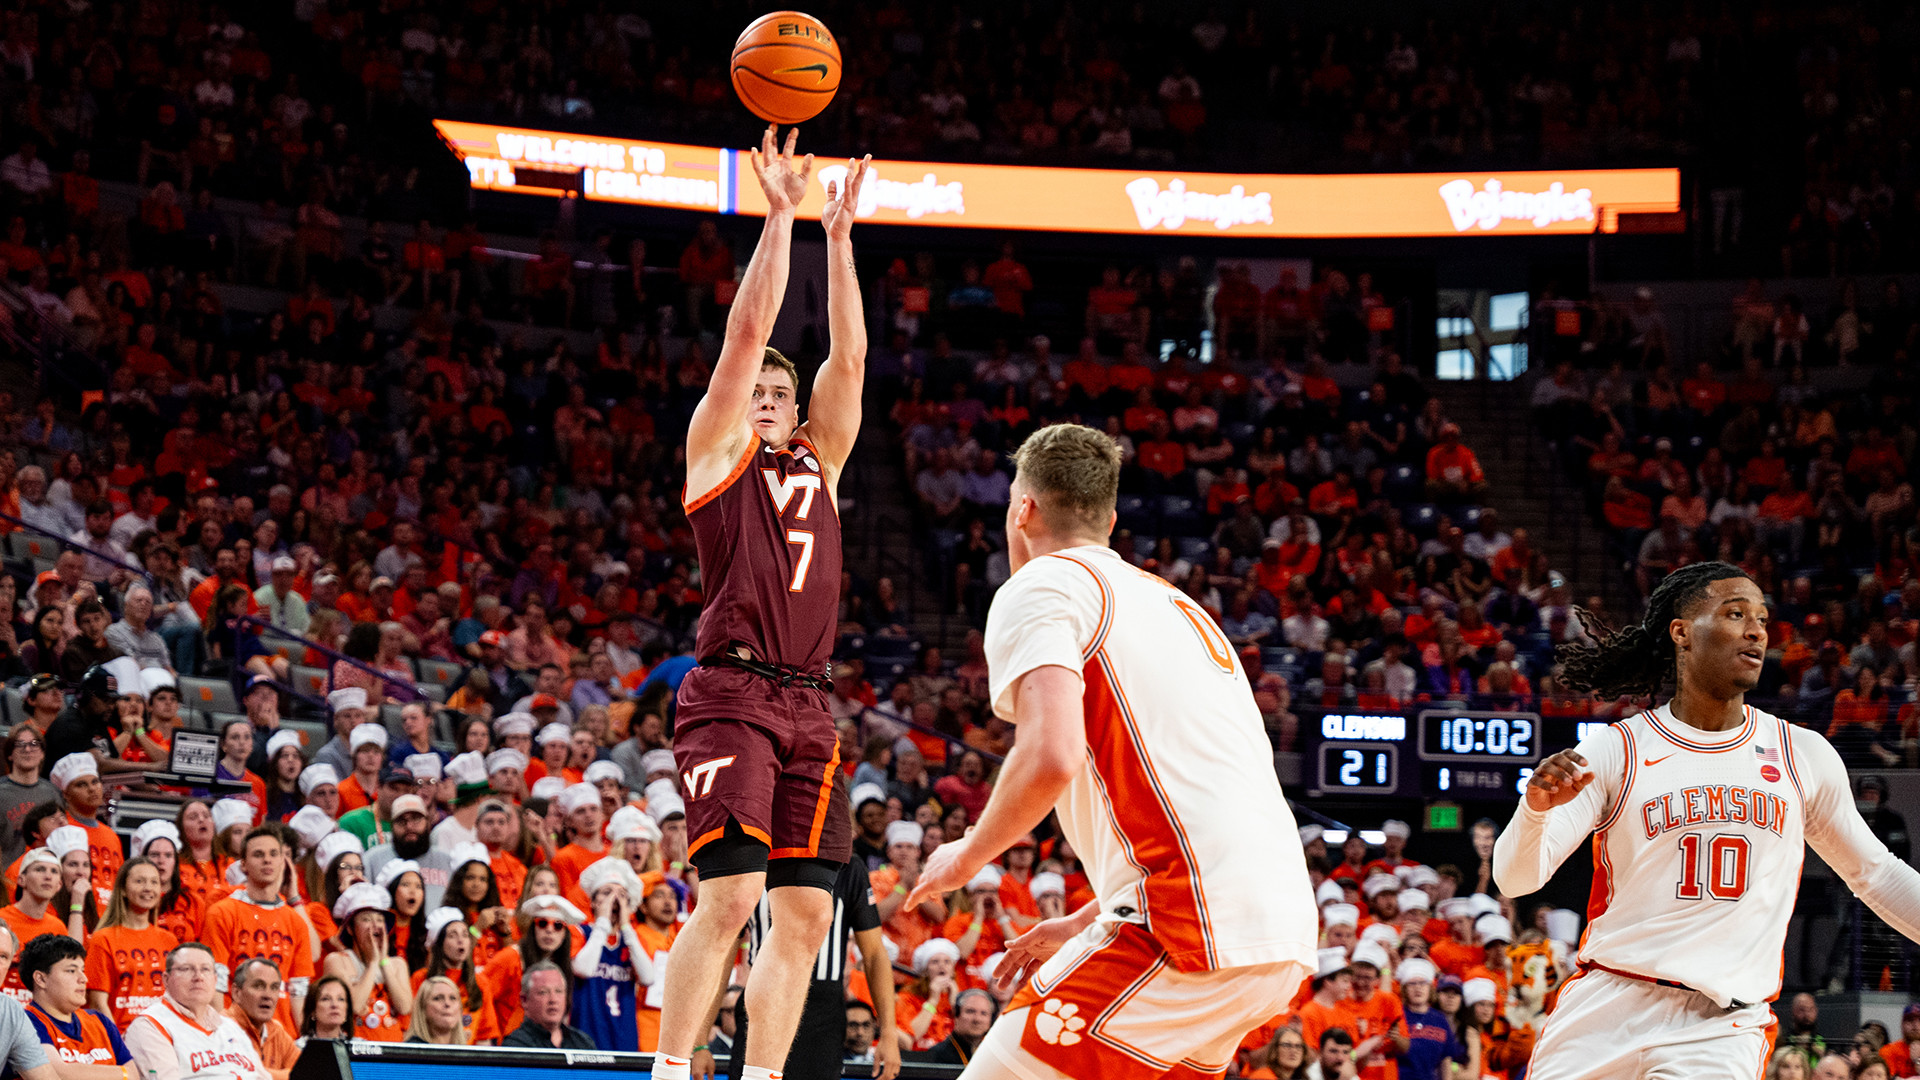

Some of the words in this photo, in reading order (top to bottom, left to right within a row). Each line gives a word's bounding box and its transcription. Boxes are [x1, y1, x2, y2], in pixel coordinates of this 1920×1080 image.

[496, 133, 625, 170] WELCOME
[628, 146, 665, 174] TO
[1125, 177, 1273, 230] Bojangles
[1439, 178, 1594, 232] Bojangles
[760, 468, 821, 521] VT
[787, 528, 814, 593] 7
[1170, 596, 1237, 679] 0
[1321, 714, 1406, 741] CLEMSON
[1440, 717, 1532, 755] 10:02
[683, 755, 737, 801] VT
[1340, 750, 1387, 786] 21
[1641, 785, 1788, 840] CLEMSON
[1676, 833, 1752, 901] 10
